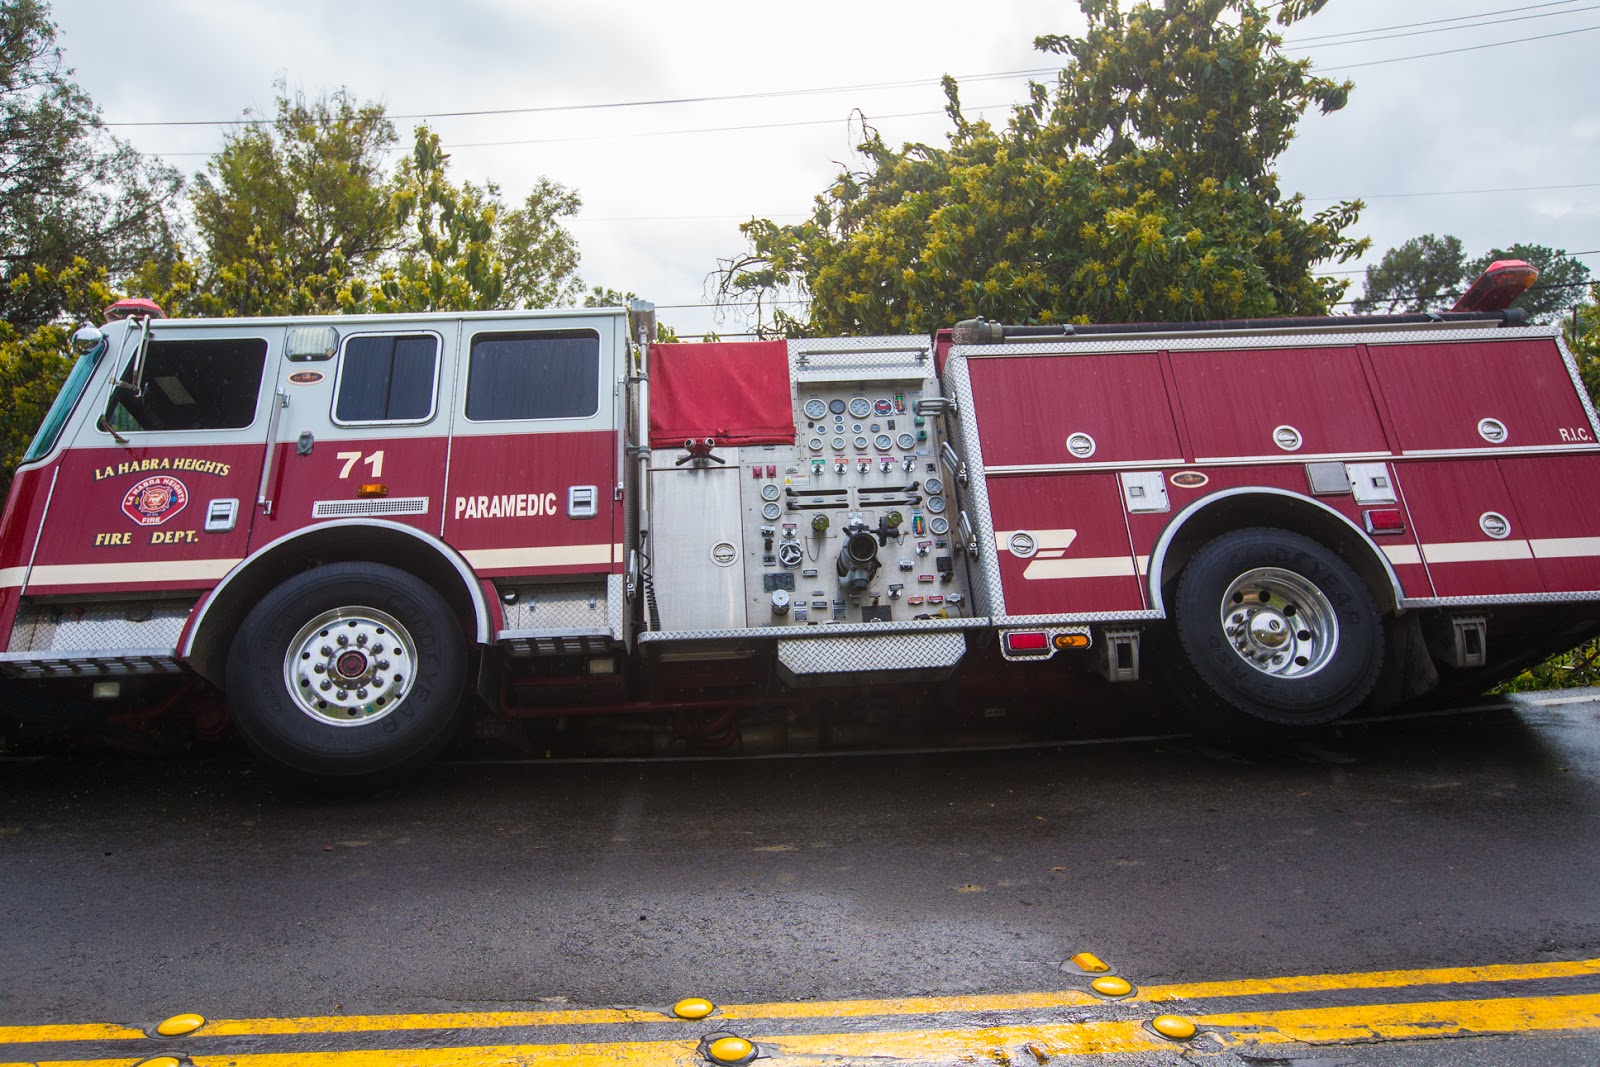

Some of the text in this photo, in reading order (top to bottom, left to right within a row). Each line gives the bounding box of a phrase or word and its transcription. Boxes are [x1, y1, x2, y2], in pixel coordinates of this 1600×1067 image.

[1559, 427, 1592, 441] R.I.C.
[95, 457, 231, 480] LA HABRA HEIGHTS
[336, 450, 384, 479] 71
[125, 478, 185, 506] LA HABRA HEIGHTS
[455, 492, 557, 519] PARAMEDIC
[95, 530, 199, 546] FIRE DEPT.
